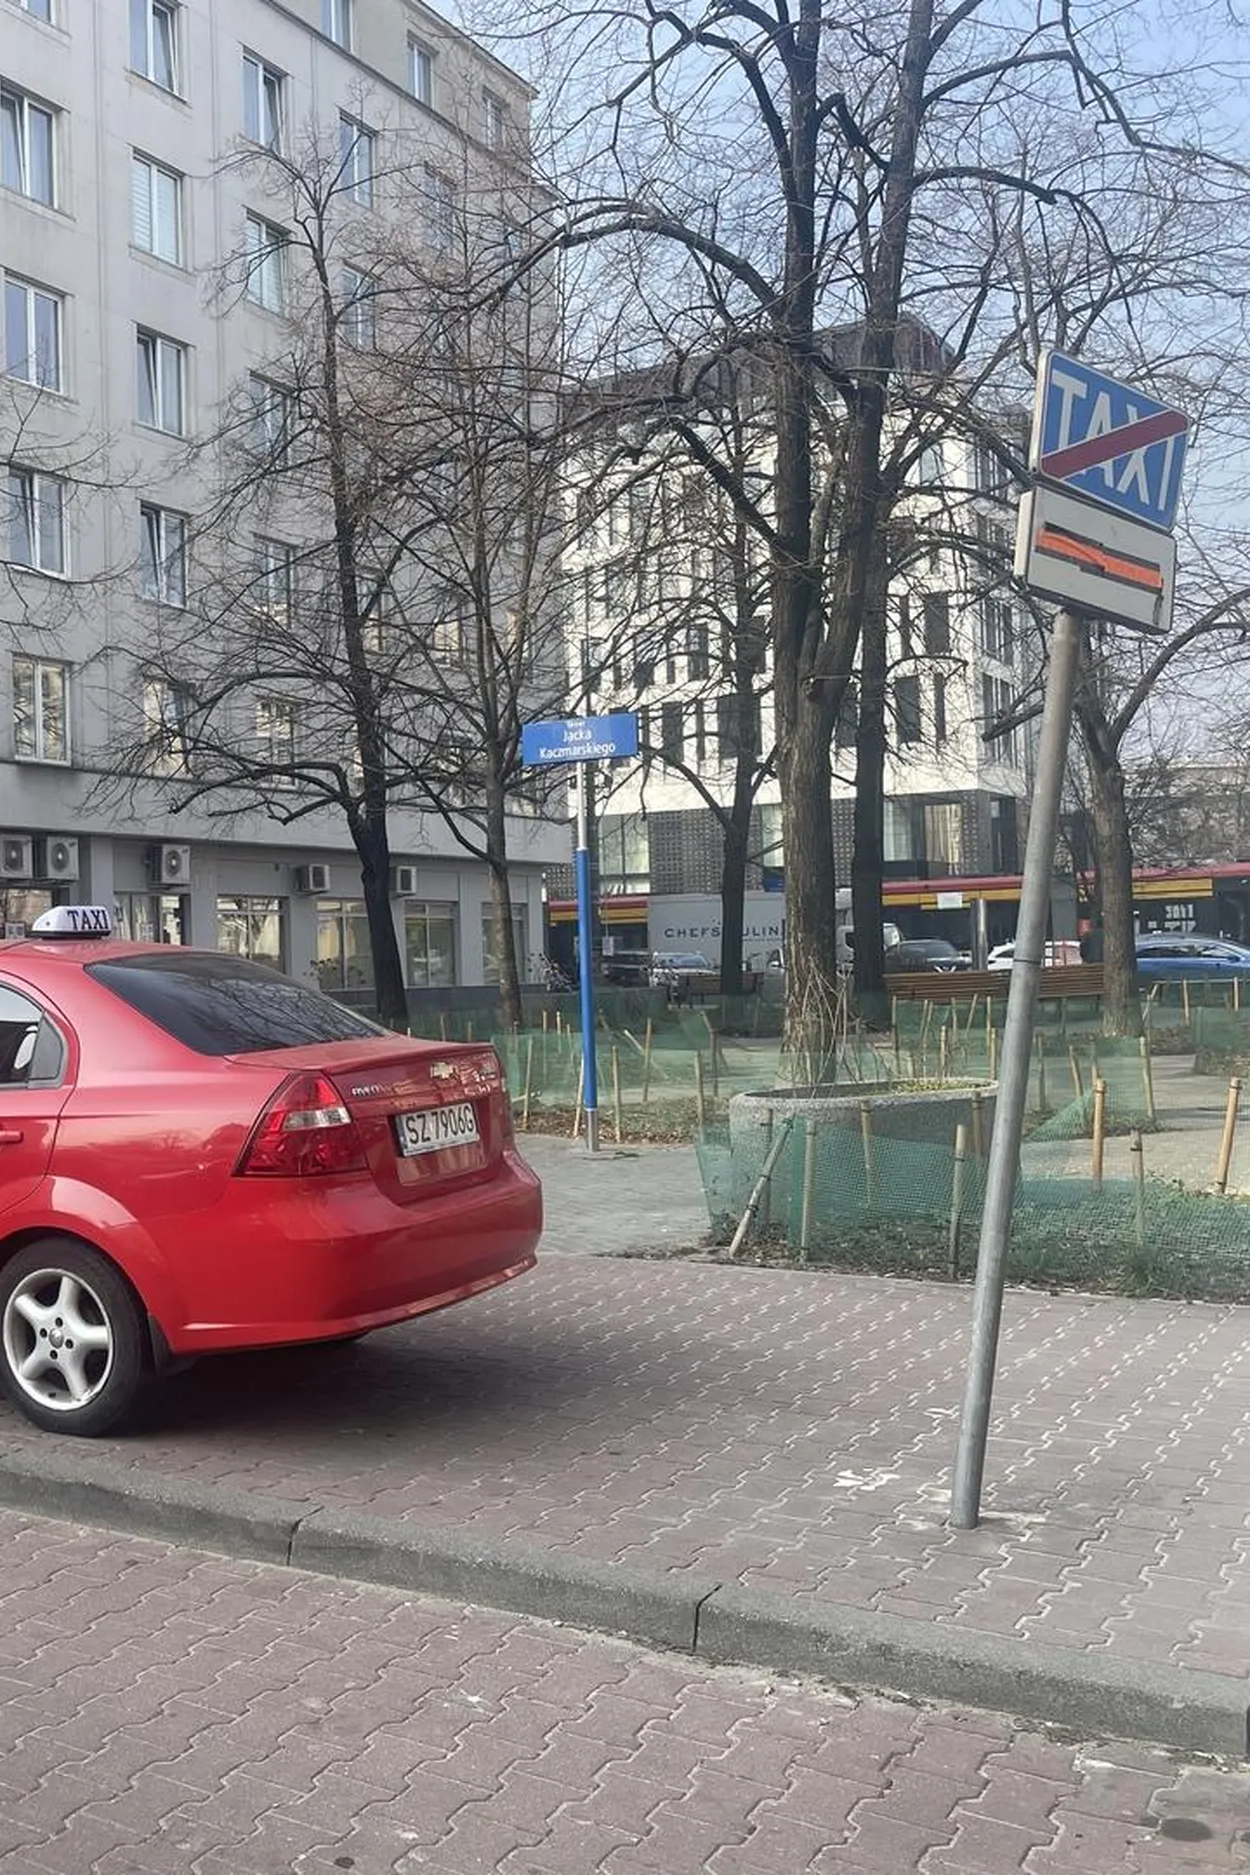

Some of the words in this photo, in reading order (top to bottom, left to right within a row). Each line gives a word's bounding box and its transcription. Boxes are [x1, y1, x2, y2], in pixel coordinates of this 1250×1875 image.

[1052, 368, 1175, 511] TAXI
[563, 729, 592, 742] Jacka
[539, 742, 616, 759] Kaczmarskiego
[67, 909, 109, 930] TAXI
[664, 926, 721, 939] CHEFS
[406, 1113, 431, 1145] SZ
